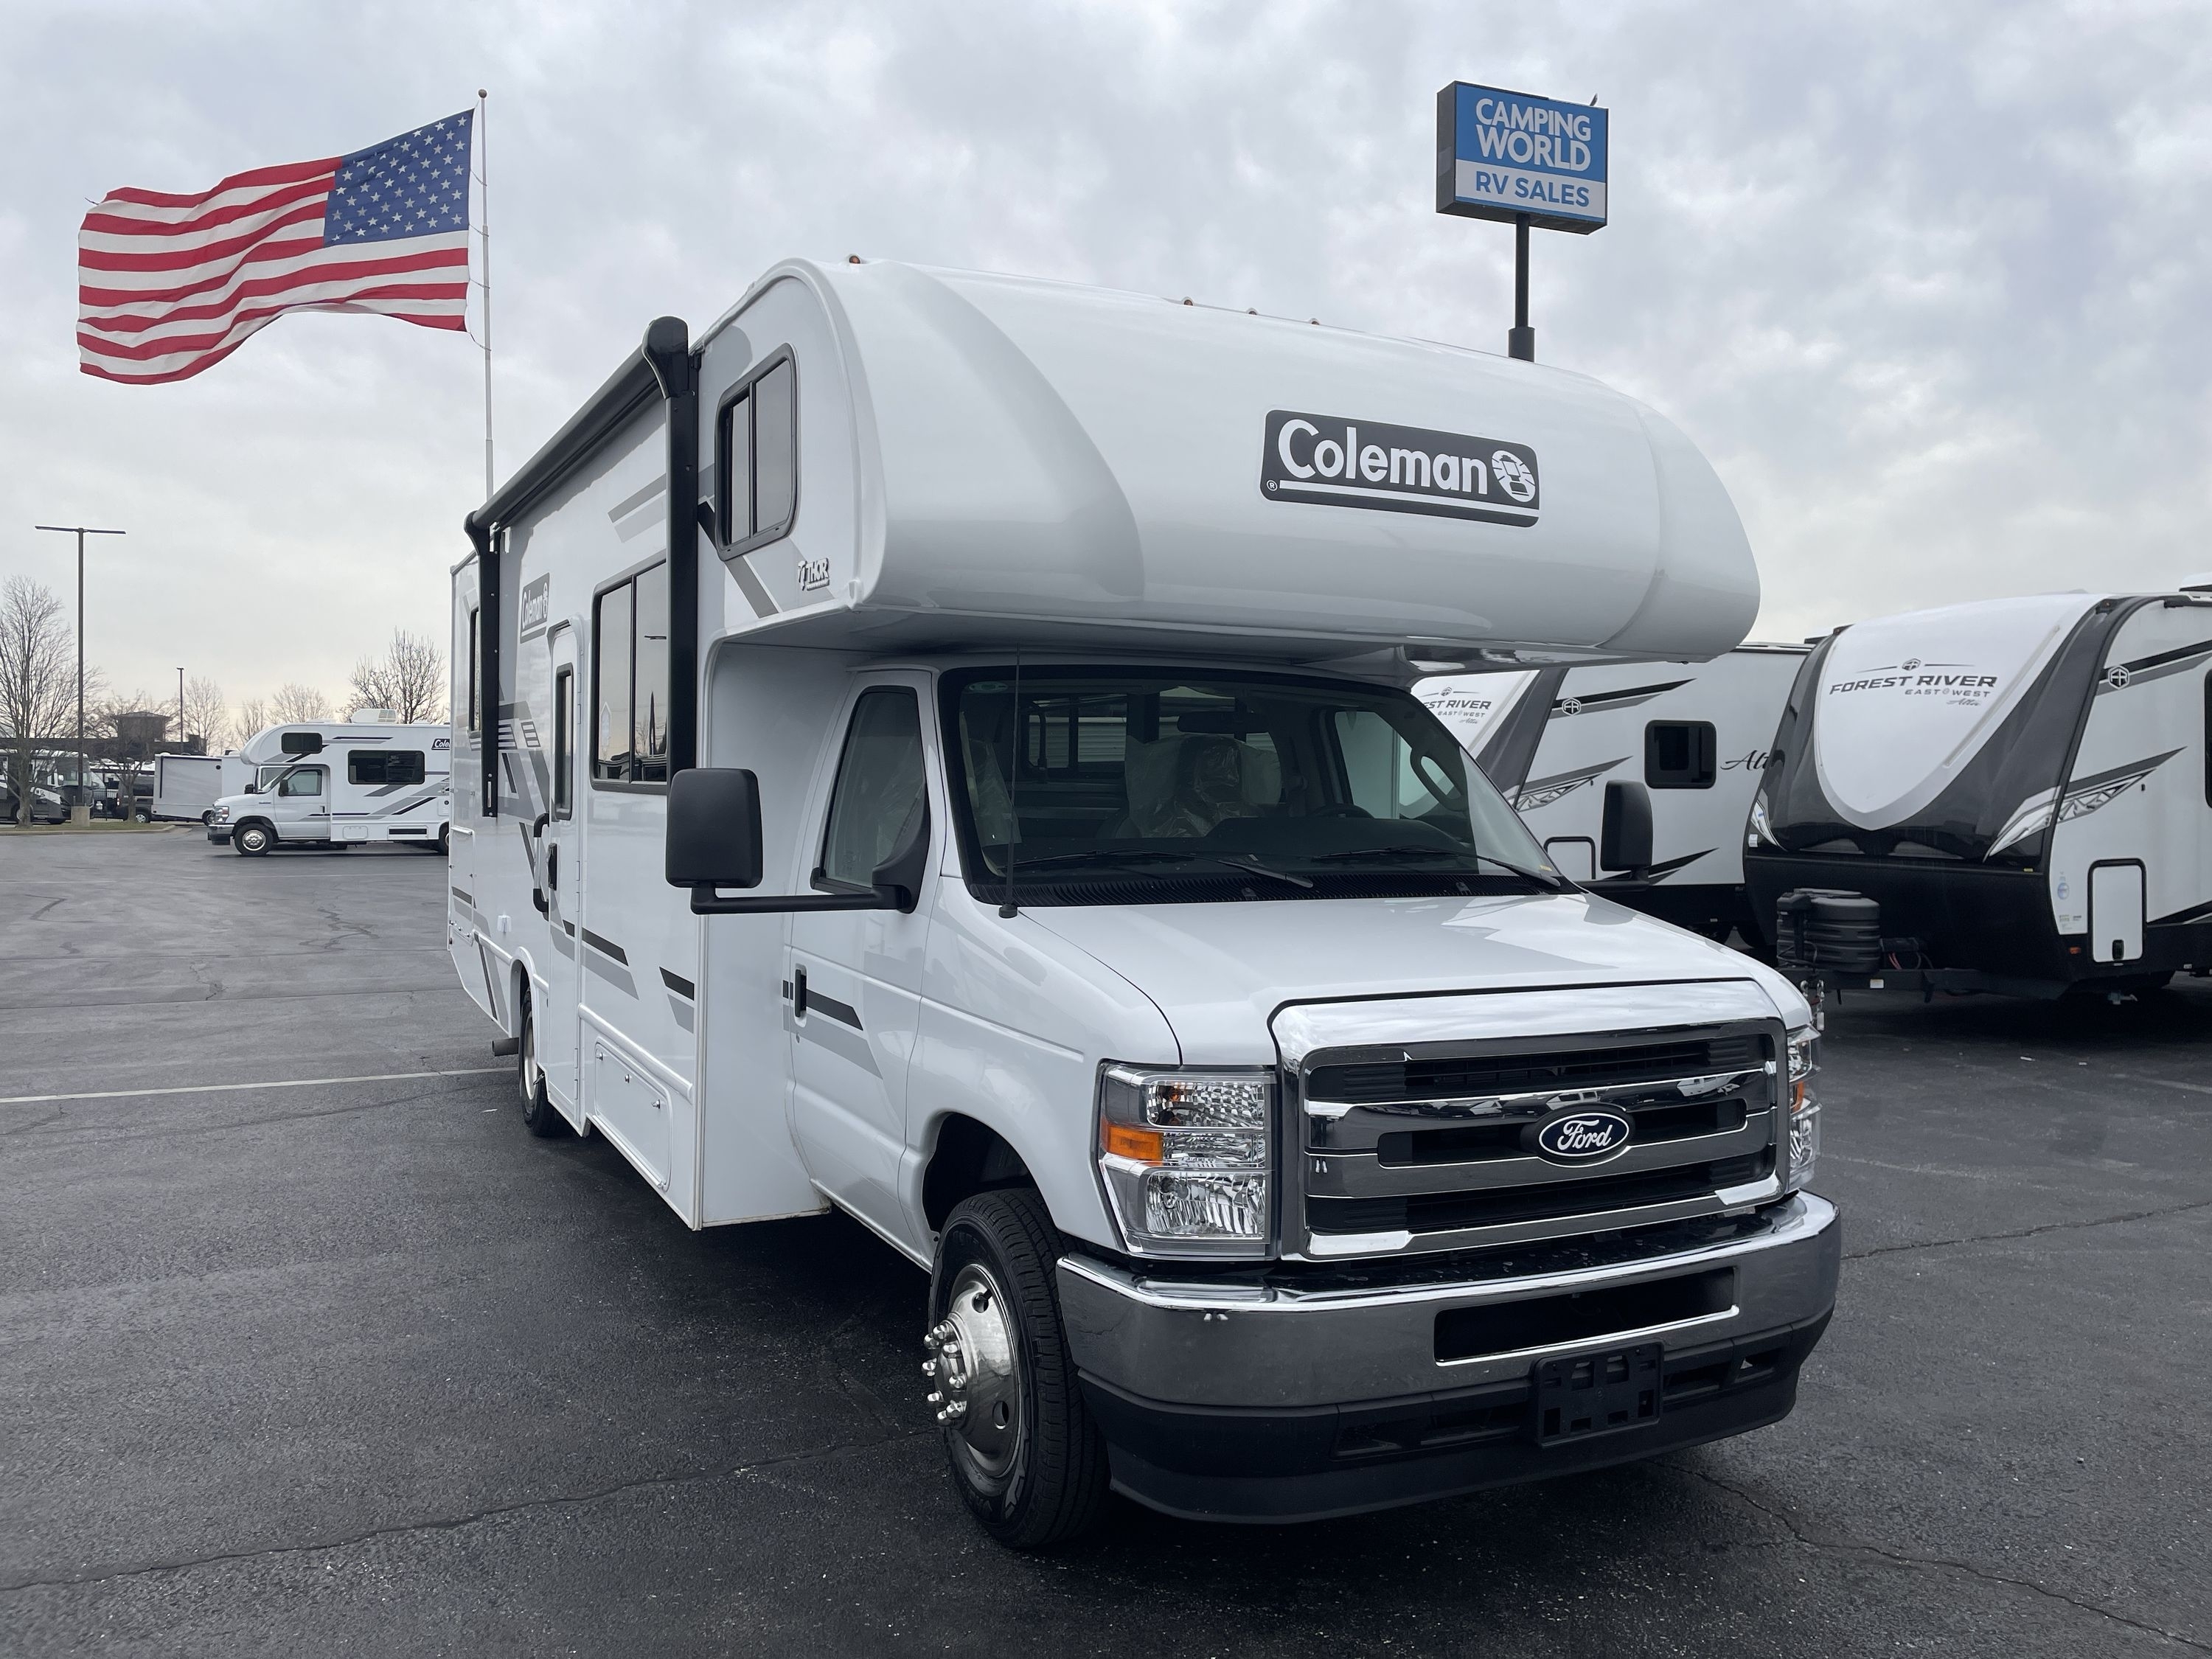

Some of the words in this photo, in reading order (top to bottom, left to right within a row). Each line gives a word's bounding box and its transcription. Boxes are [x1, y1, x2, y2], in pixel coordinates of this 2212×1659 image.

[1476, 98, 1591, 141] CAMPING
[1476, 125, 1591, 172] WORLD
[1475, 170, 1509, 195] RV
[1514, 177, 1590, 207] SALES
[1278, 419, 1488, 495] Coleman
[805, 558, 829, 583] THOR
[521, 590, 543, 630] Coleman
[1829, 675, 1913, 695] FOREST
[1917, 675, 1997, 688] RIVER
[1952, 689, 1991, 698] WEST
[1423, 700, 1446, 709] EST
[1446, 700, 1492, 709] RIVER
[434, 739, 450, 748] Cole
[1719, 749, 1770, 771] Alt
[1557, 1119, 1613, 1150] Ford
